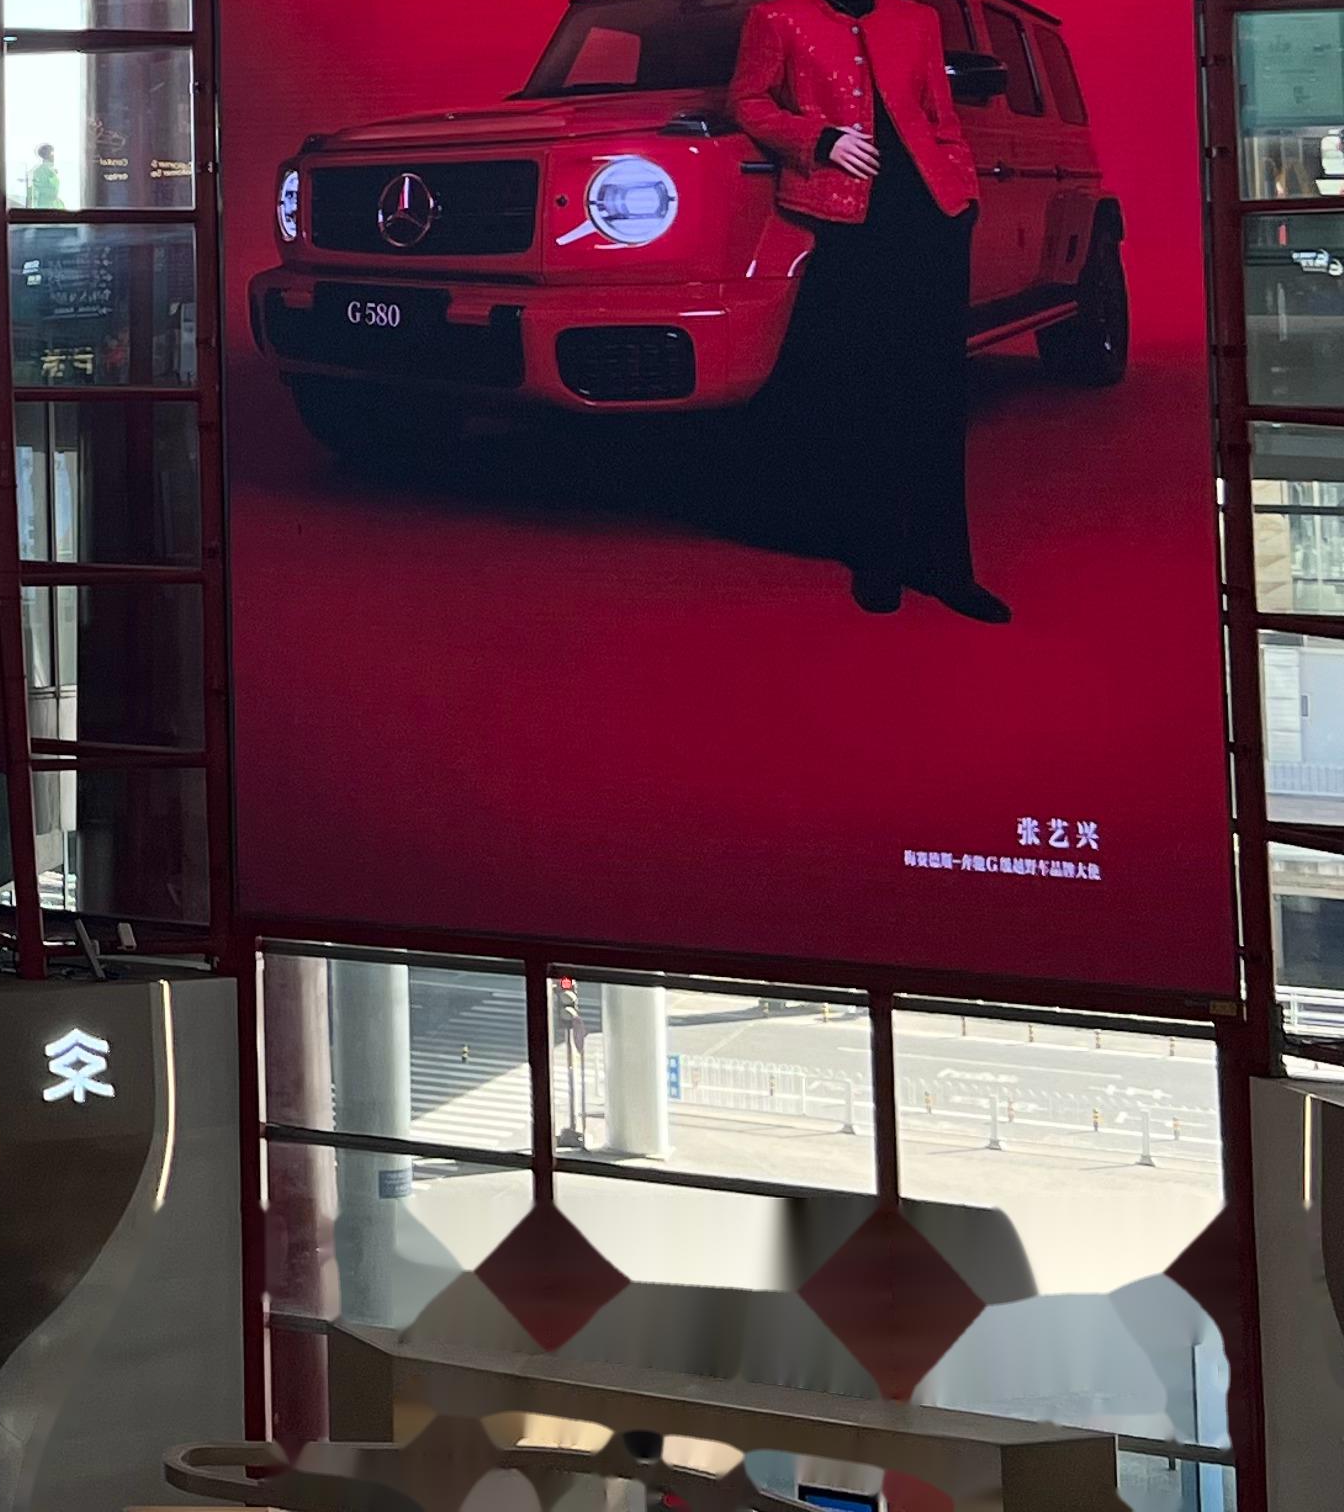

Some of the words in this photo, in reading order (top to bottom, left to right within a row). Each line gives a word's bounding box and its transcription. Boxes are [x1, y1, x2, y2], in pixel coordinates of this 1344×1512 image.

[365, 302, 401, 327] 580
[1017, 817, 1099, 851] 张艺兴
